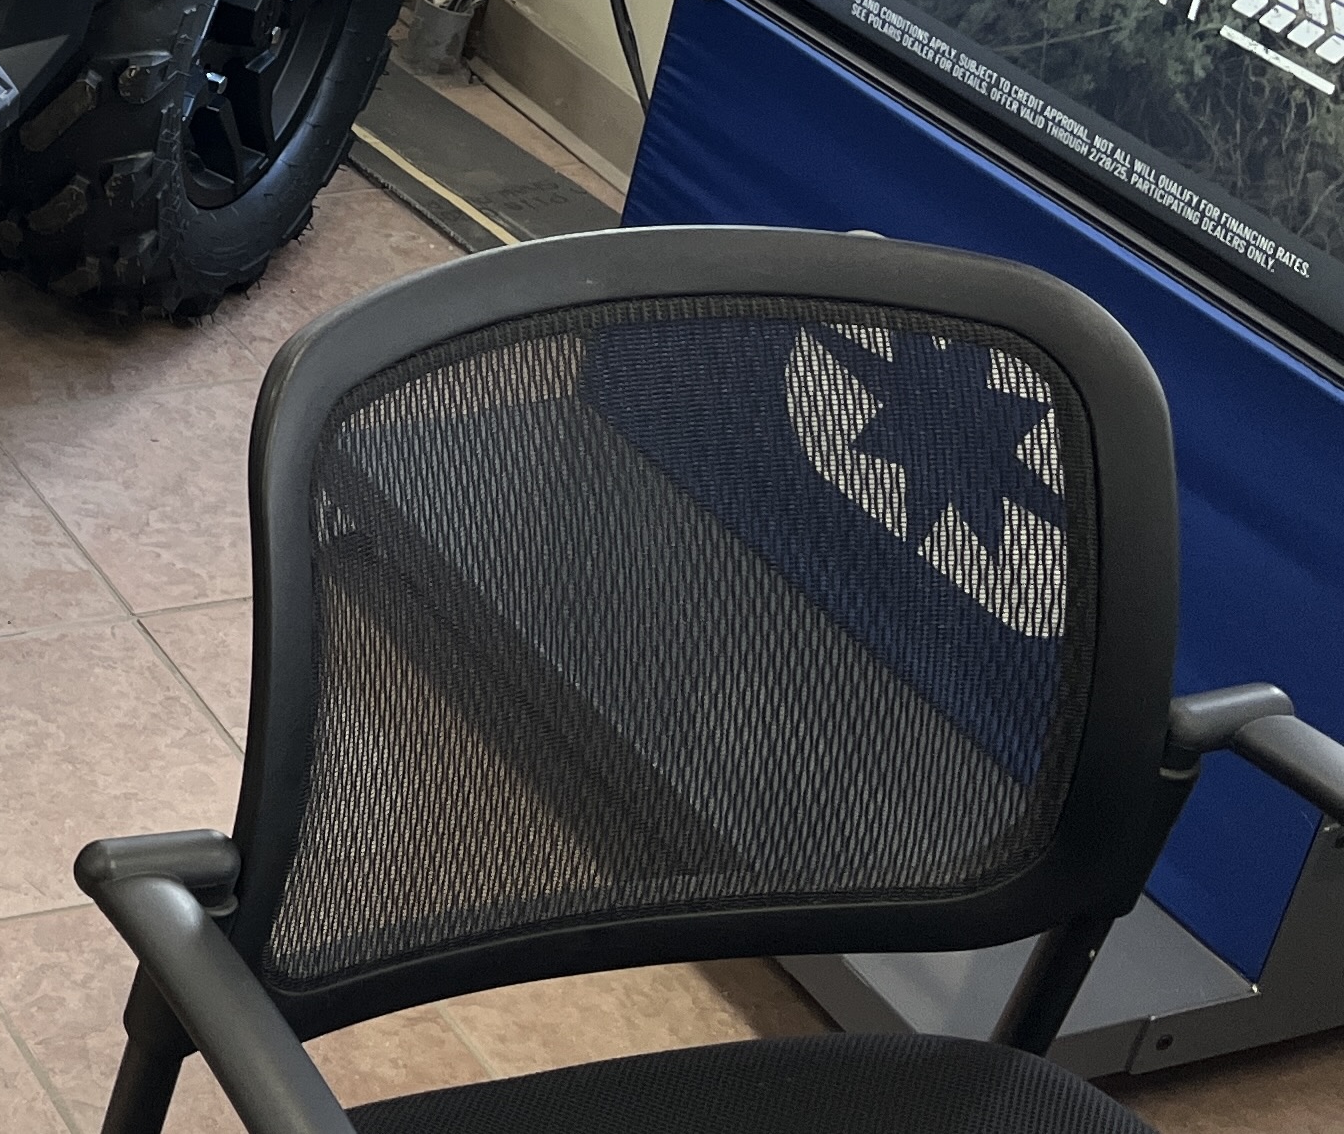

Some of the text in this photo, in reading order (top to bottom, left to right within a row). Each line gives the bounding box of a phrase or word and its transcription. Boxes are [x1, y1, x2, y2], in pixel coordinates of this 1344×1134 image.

[851, 3, 866, 22] SEE
[867, 13, 902, 42] POLARIS
[901, 33, 935, 65] DEALER
[934, 55, 953, 74] FOR
[952, 66, 990, 96] DETAILS.
[990, 88, 1020, 114] OFFER
[1019, 106, 1046, 130] VALID
[1046, 120, 1089, 157] THROUGH
[1130, 173, 1202, 225] PARTICIPATING
[1201, 216, 1248, 254] DEALERS
[1247, 246, 1276, 274] ONLY.
[880, 6, 930, 44] CONDITIONS
[928, 36, 958, 64] APPLY.
[958, 53, 998, 85] SUBJECT
[998, 76, 1011, 93] TO
[1011, 85, 1044, 113] CREDIT
[1043, 105, 1092, 144] APPROVAL.
[1093, 134, 1115, 155] NOT
[1113, 148, 1131, 168] ALL
[1133, 158, 1156, 184] WILL
[1157, 174, 1200, 208] QUALIFY
[1198, 198, 1222, 220] FOR
[1220, 212, 1276, 255] FINANCING
[1275, 246, 1311, 279] RATES.
